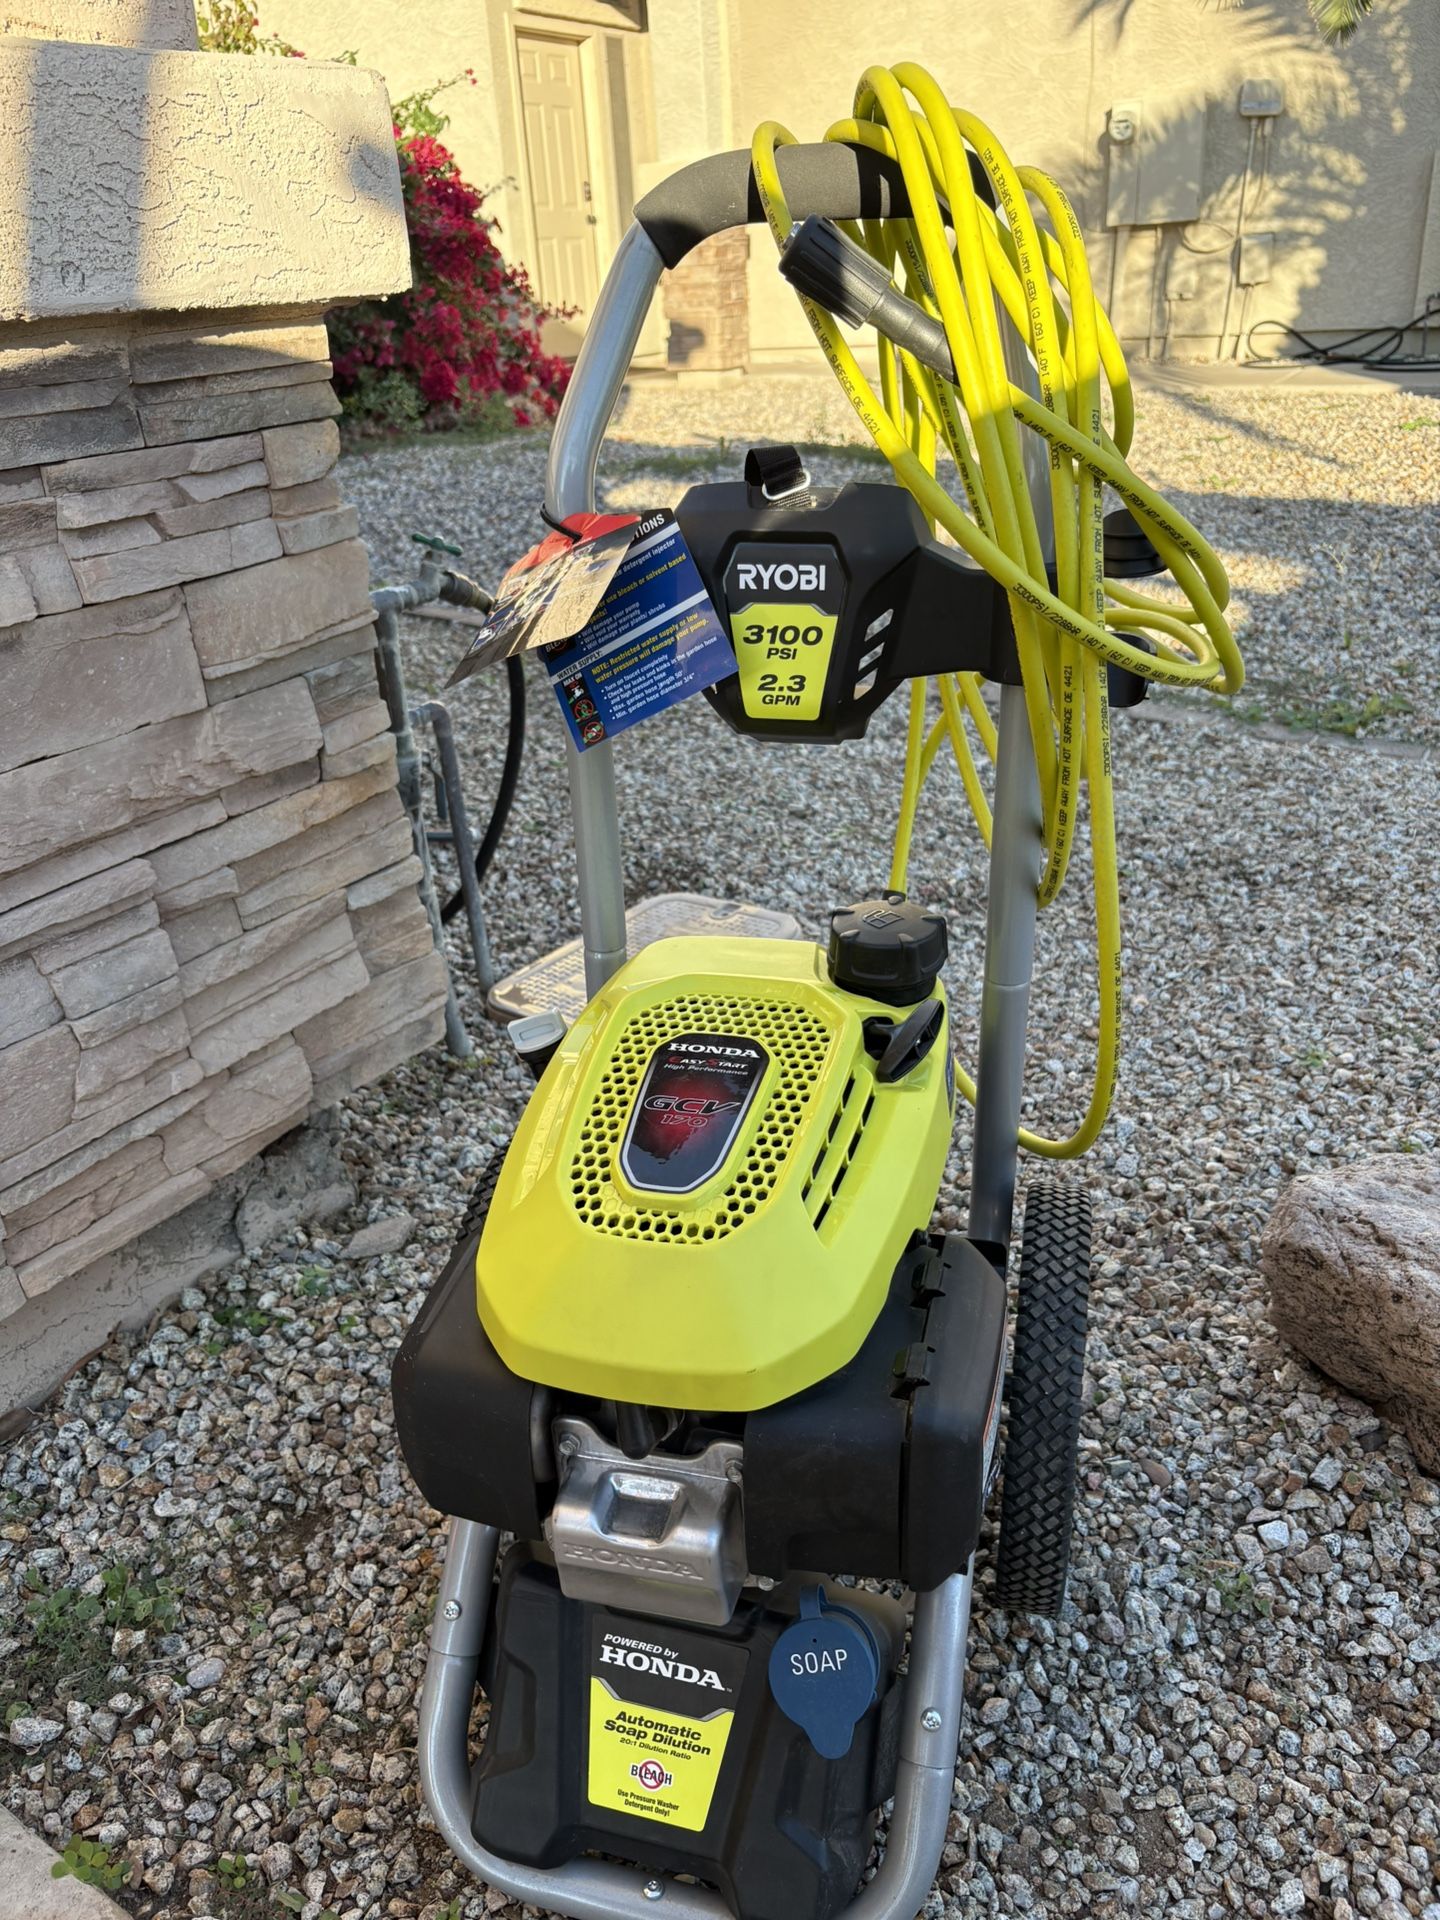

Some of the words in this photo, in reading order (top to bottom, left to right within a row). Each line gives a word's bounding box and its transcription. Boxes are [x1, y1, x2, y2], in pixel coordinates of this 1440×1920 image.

[808, 308, 822, 334] FROM
[820, 334, 832, 352] HOT
[830, 354, 855, 394] SURFACE
[863, 413, 881, 436] 4421
[737, 564, 826, 591] RYOBI
[591, 661, 609, 675] NOTE:
[609, 644, 640, 665] Restricted
[641, 634, 658, 647] water
[658, 623, 678, 639] supply
[686, 613, 697, 622] low
[743, 625, 824, 646] 3100
[557, 664, 577, 679] WATER
[578, 650, 603, 667] SUPPLY:
[595, 671, 612, 683] water
[613, 657, 638, 674] pressure
[638, 649, 651, 659] will
[651, 636, 674, 653] damage
[675, 628, 690, 640] your
[766, 648, 798, 660] PSI
[604, 682, 615, 691] Turn
[623, 668, 640, 681] faucet
[640, 653, 668, 673] completely
[757, 674, 807, 693] 2.3
[1064, 666, 1072, 687] 4421
[762, 695, 801, 706] GPM
[1063, 708, 1072, 743] SURFACE
[1063, 748, 1071, 764] HOT
[1062, 767, 1071, 786] FROM
[1059, 810, 1067, 826] KEEP
[667, 1043, 760, 1058] HONDA
[687, 1066, 749, 1075] Performance
[644, 1095, 741, 1115] GCV
[660, 1114, 707, 1127] 170
[563, 1544, 703, 1580] HONDA
[604, 1633, 662, 1654] POWERED
[664, 1648, 679, 1659] by
[599, 1645, 725, 1691] HONDA
[790, 1648, 848, 1676] SOAP
[604, 1719, 648, 1740] Soap
[652, 1732, 711, 1755] Dilution
[616, 1711, 702, 1741] Automatic
[620, 1737, 637, 1746] 20:1
[638, 1741, 668, 1755] Dilution
[670, 1750, 691, 1760] Ratio
[631, 1764, 672, 1785] BLEACH
[617, 1788, 629, 1797] Use
[630, 1791, 656, 1805] Pressure
[657, 1798, 680, 1811] Washer
[624, 1799, 654, 1812] Detergent
[654, 1806, 670, 1817] Only!
